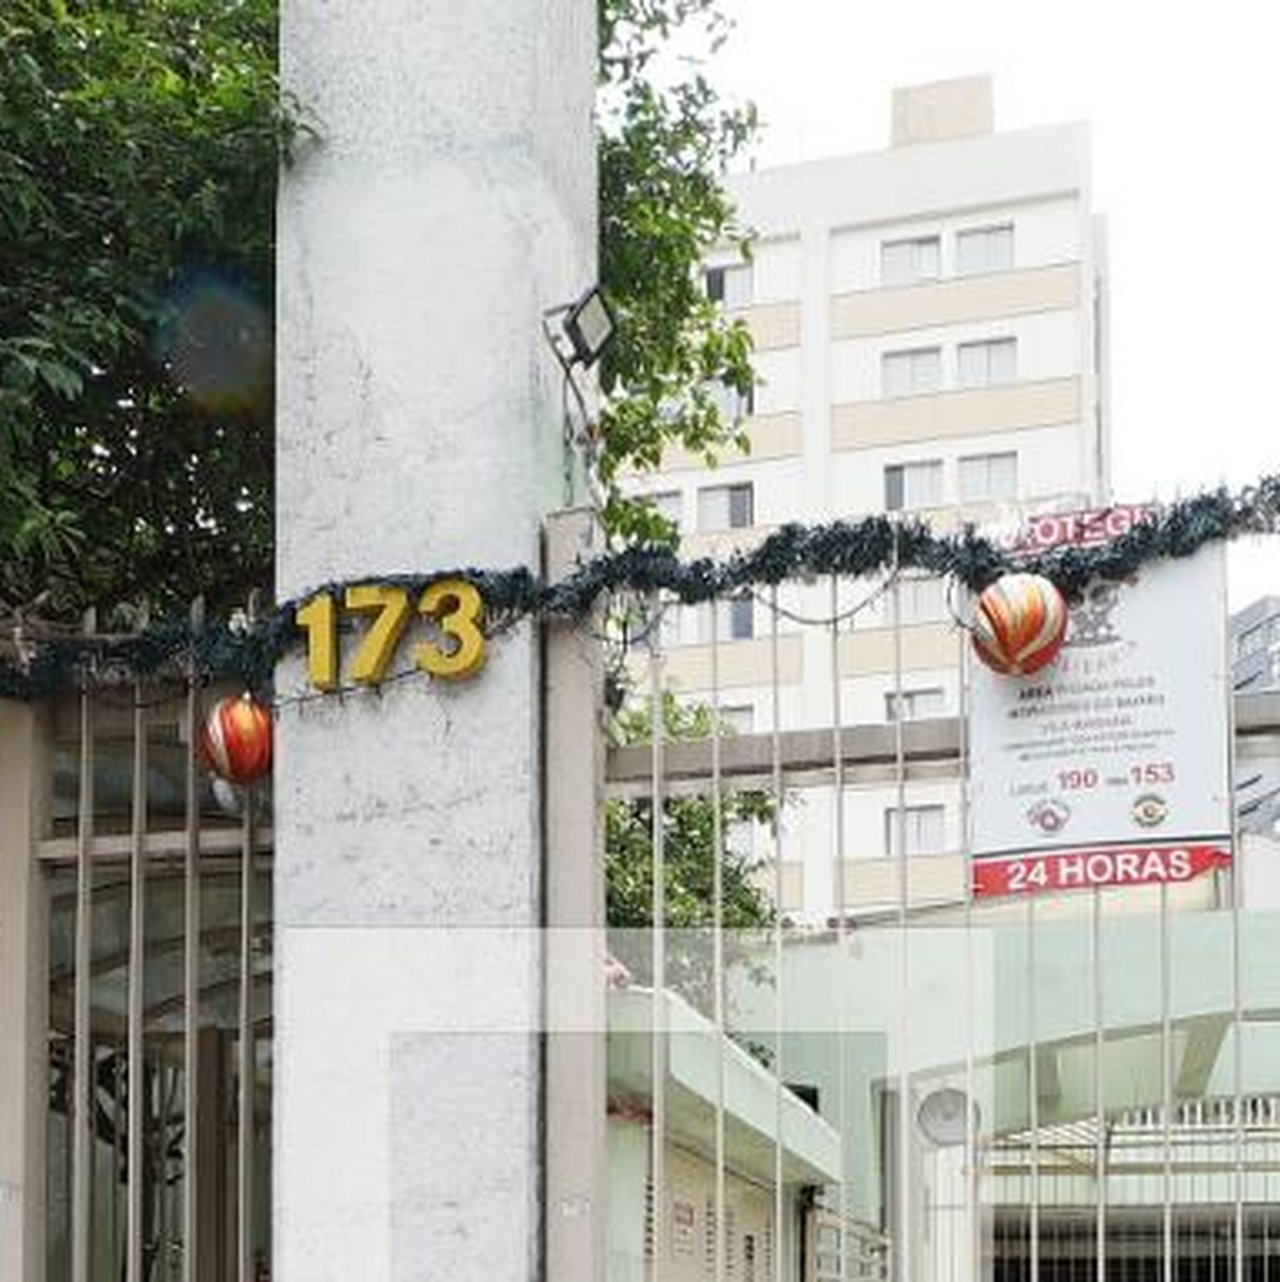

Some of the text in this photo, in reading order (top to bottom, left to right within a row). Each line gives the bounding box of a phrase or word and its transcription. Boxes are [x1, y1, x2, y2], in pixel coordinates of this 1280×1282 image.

[295, 576, 486, 695] 173
[1057, 768, 1099, 790] 190
[1130, 762, 1176, 785] 153
[1006, 850, 1192, 891] 24 HORAS
